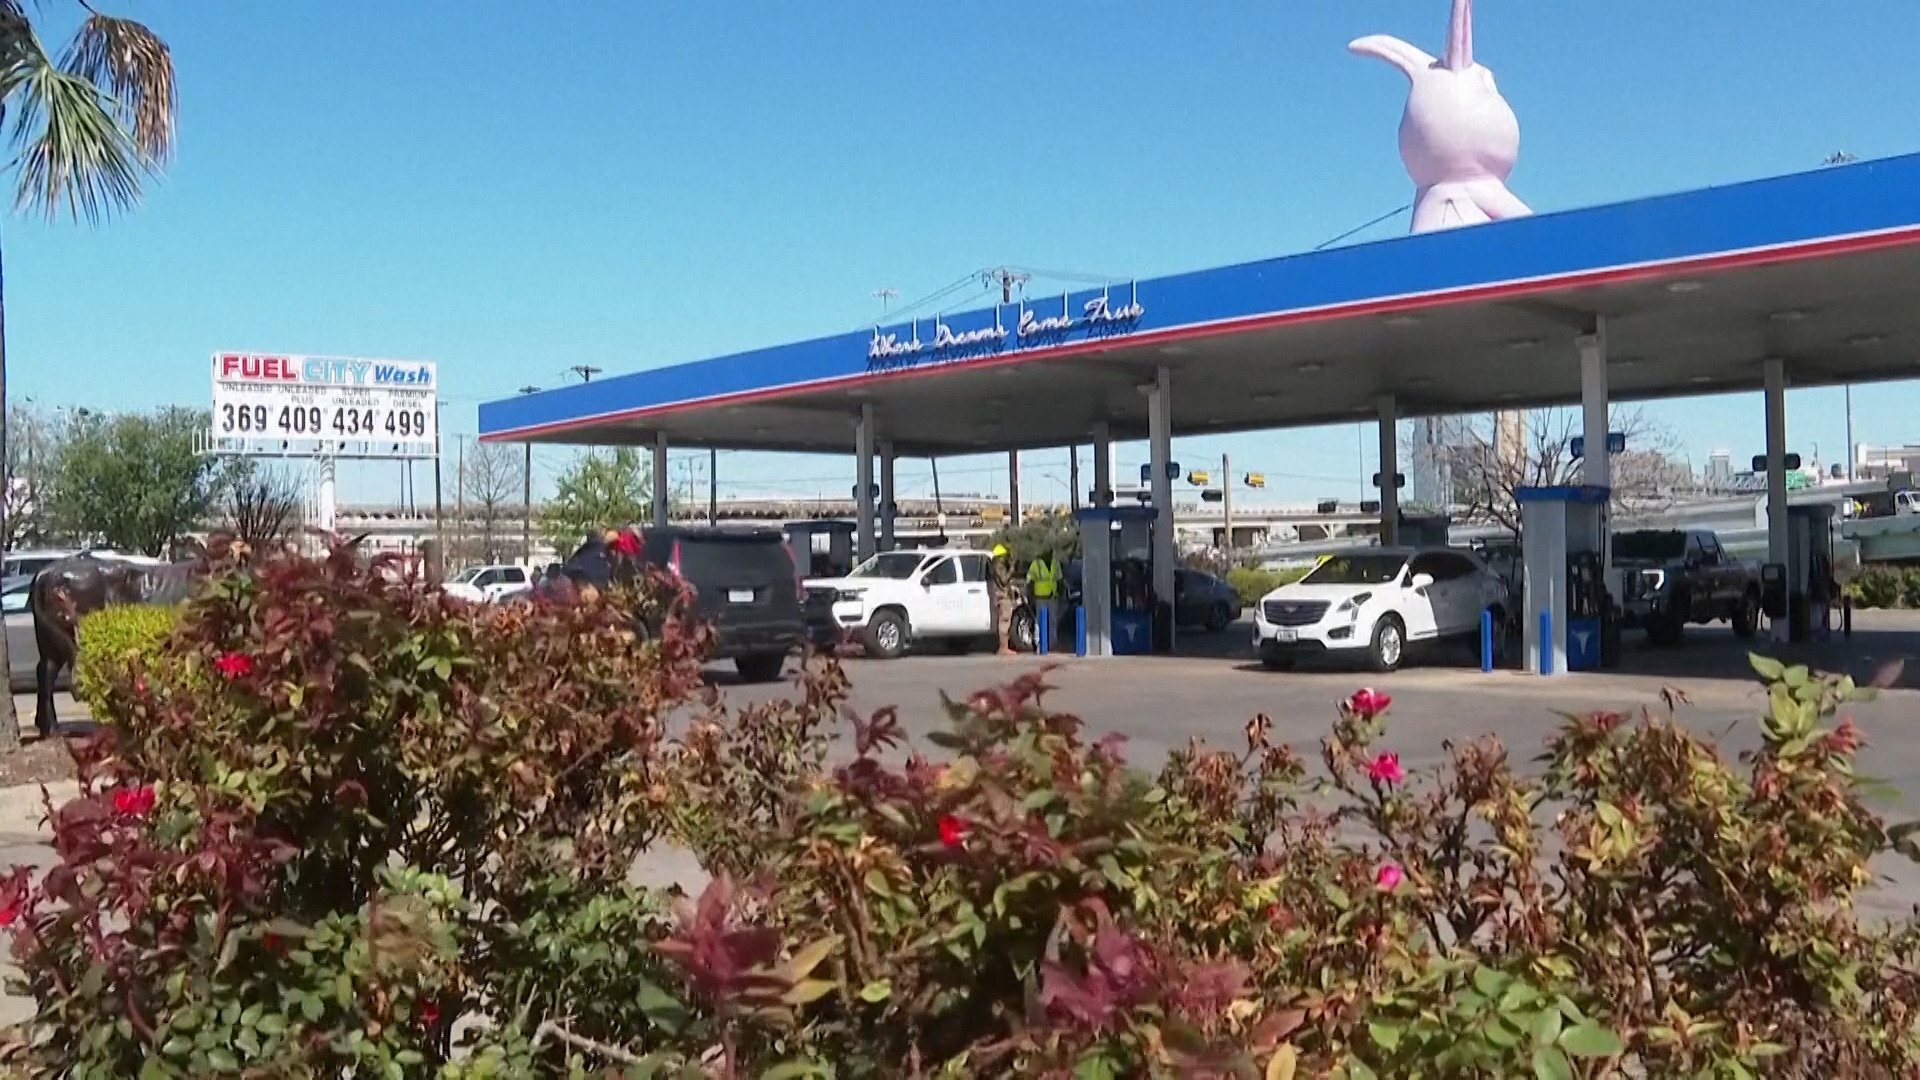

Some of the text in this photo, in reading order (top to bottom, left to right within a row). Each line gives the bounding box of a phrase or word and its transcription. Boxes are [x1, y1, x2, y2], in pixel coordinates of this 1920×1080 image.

[222, 356, 432, 385] FUEL CITY Wash
[222, 382, 273, 392] UNLEADED
[278, 384, 327, 395] UNLEADED
[342, 388, 371, 397] SUPER
[388, 390, 428, 399] PREMIUM
[291, 395, 314, 404] PLUS
[332, 397, 381, 406] UNLEADED
[392, 400, 422, 408] DIESEL
[222, 403, 267, 432] 369
[278, 405, 322, 434] 409
[333, 407, 374, 436] 434
[385, 409, 425, 437] 499
